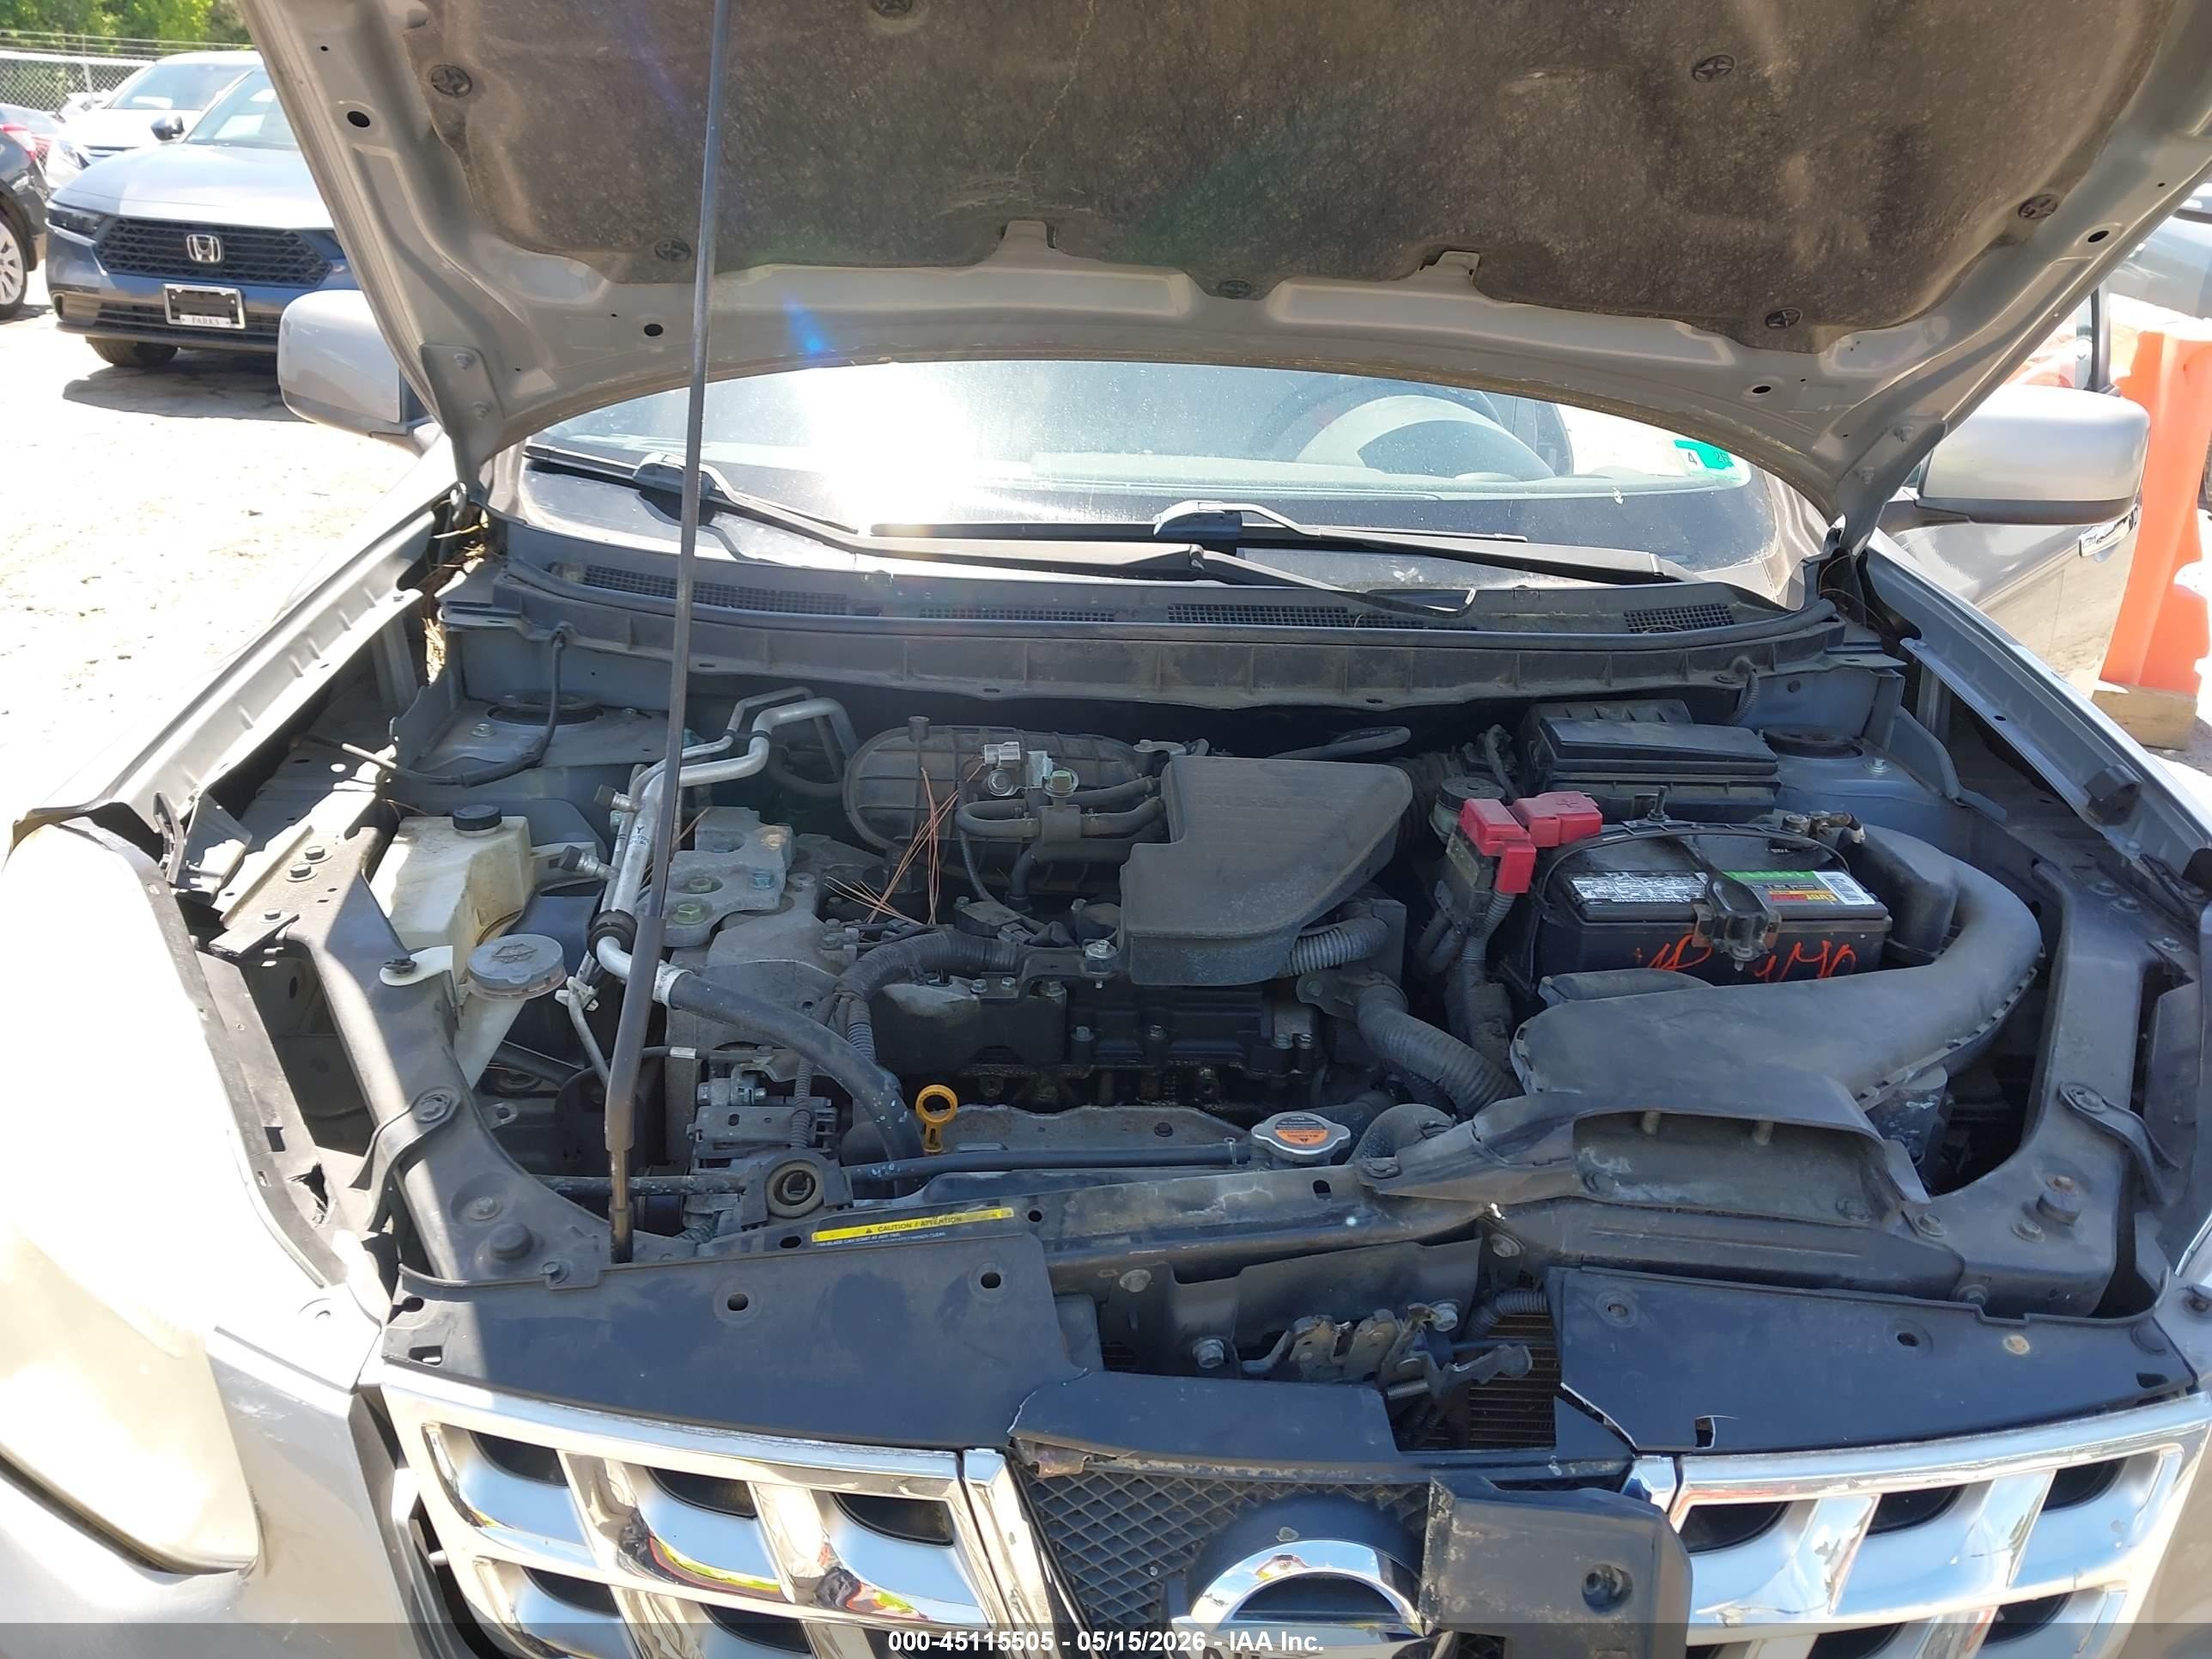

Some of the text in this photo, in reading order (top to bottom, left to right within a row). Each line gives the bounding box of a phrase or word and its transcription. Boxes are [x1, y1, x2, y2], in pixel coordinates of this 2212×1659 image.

[1687, 452, 1698, 465] 4
[878, 1222, 912, 1232] CAUTION
[921, 1216, 962, 1227] ATTENTION
